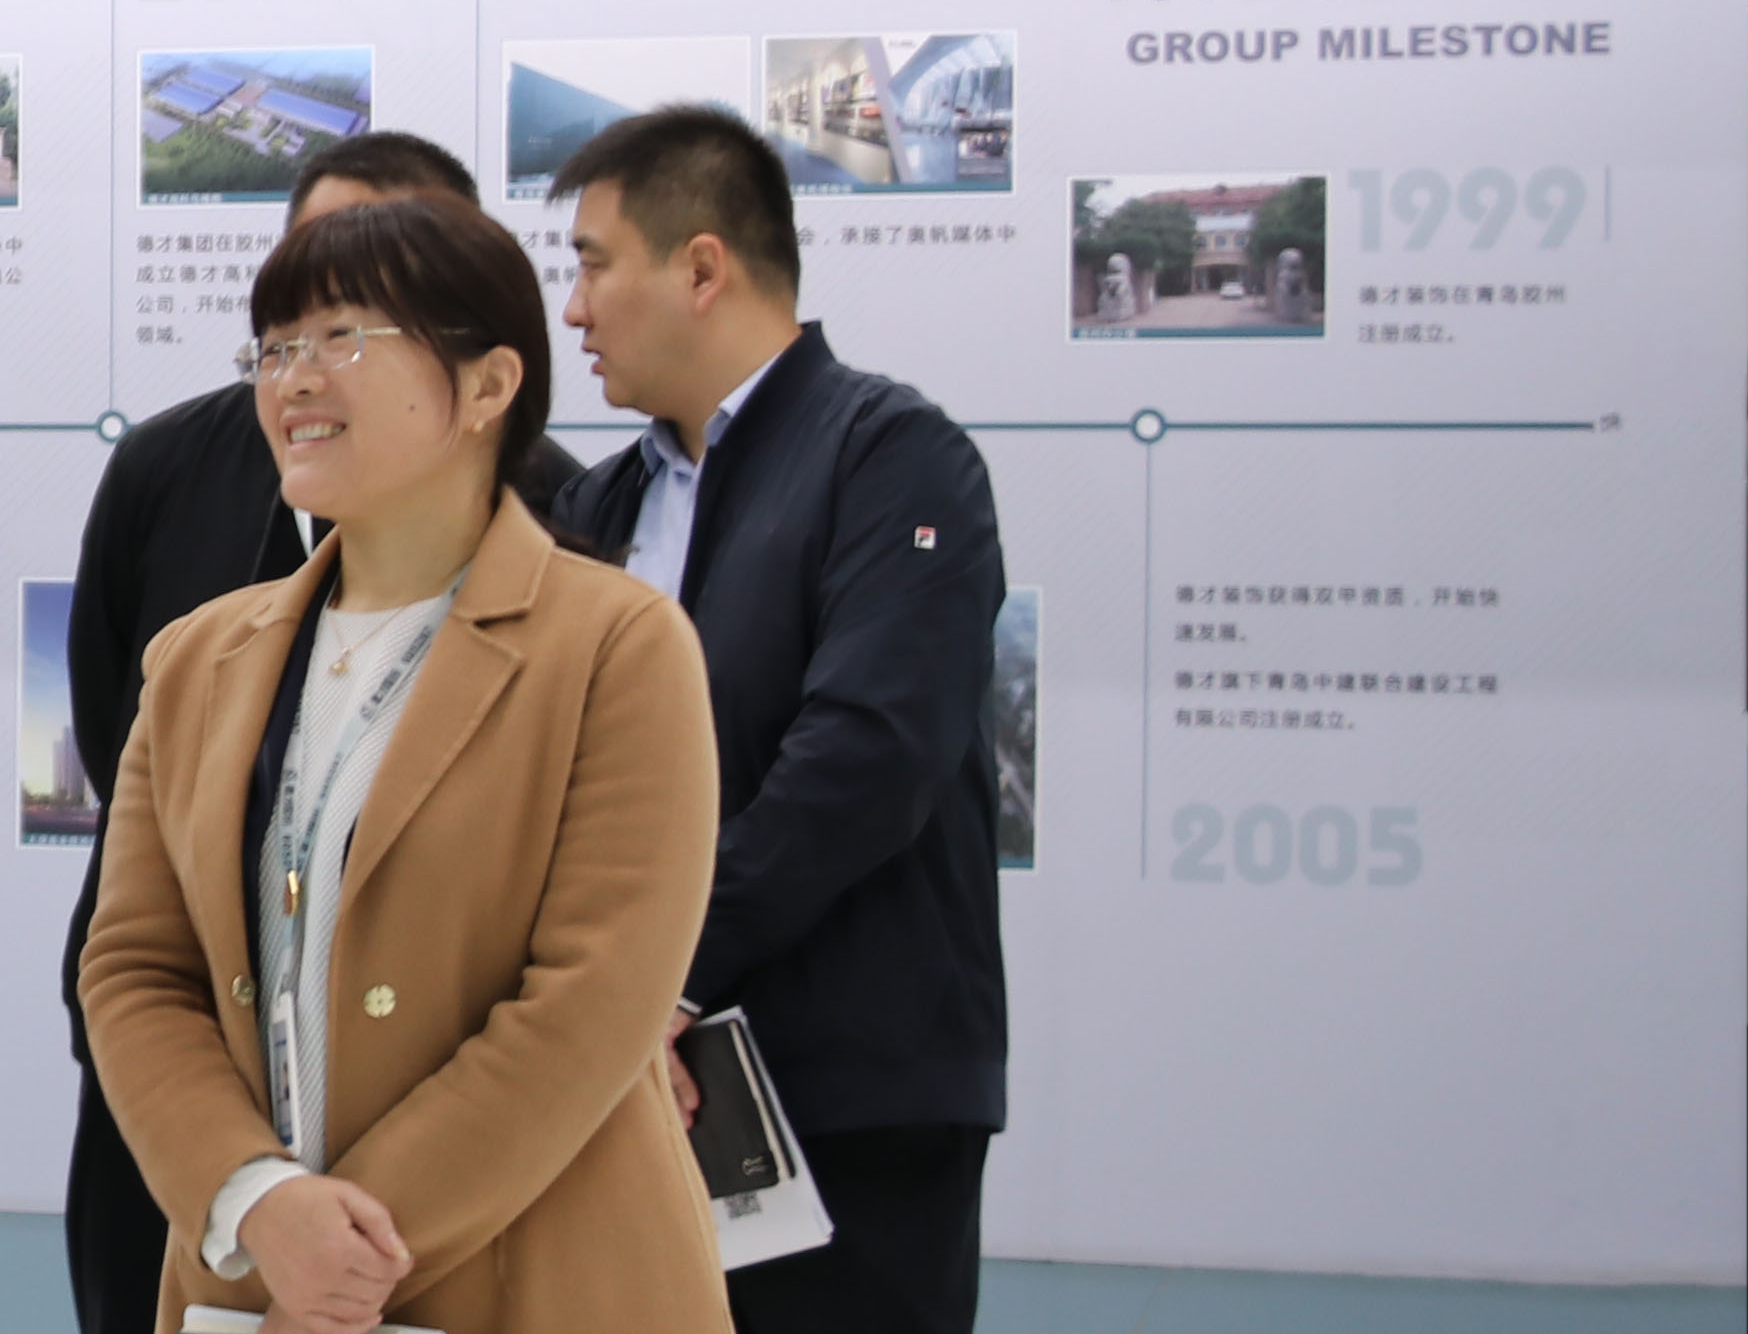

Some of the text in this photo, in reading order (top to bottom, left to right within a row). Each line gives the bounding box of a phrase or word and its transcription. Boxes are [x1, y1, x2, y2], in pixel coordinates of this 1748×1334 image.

[1126, 22, 1612, 65] GROUP MILESTONE
[1347, 167, 1588, 252] 1999
[1359, 284, 1567, 306] 德才装饰在青岛胶州
[1357, 323, 1454, 343] 注册成立。
[1170, 802, 1425, 886] 2005
